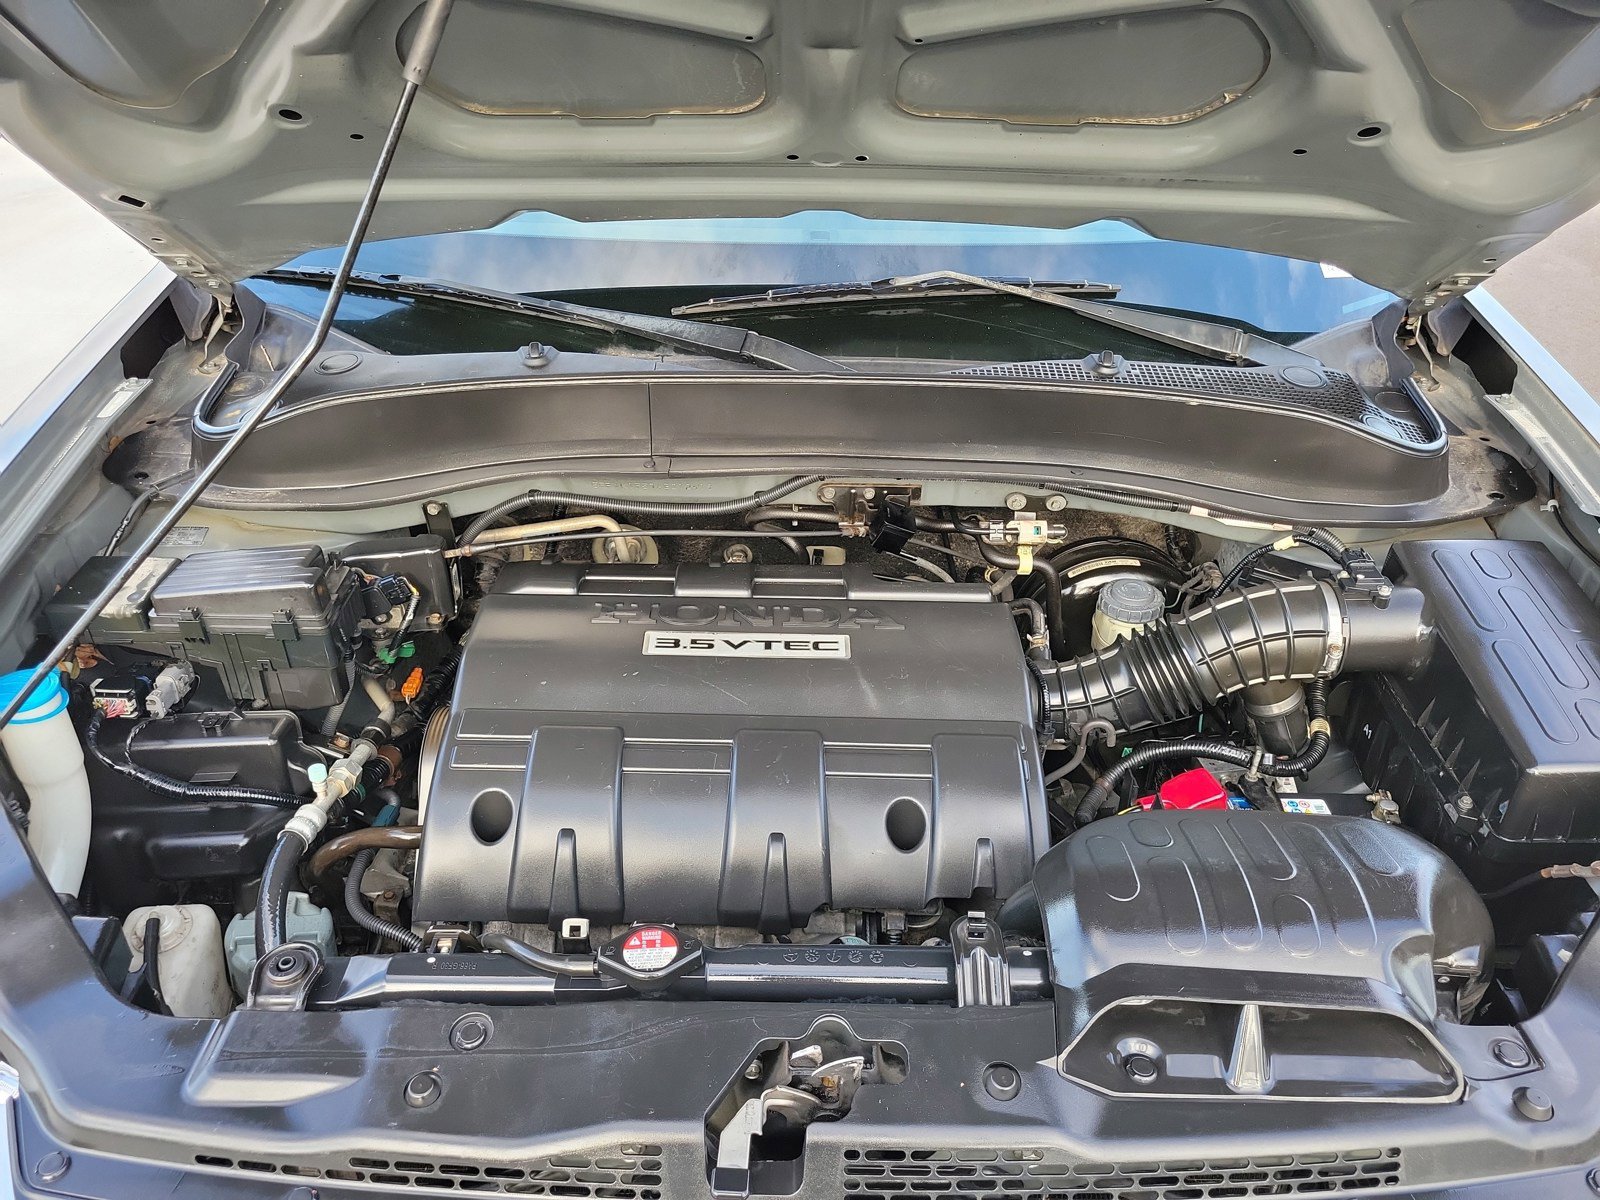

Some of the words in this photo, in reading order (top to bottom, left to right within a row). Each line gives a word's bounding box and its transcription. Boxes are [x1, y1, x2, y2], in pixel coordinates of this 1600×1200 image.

[591, 602, 906, 631] HONDA
[655, 637, 715, 650] 3.5
[721, 639, 839, 651] VTEC
